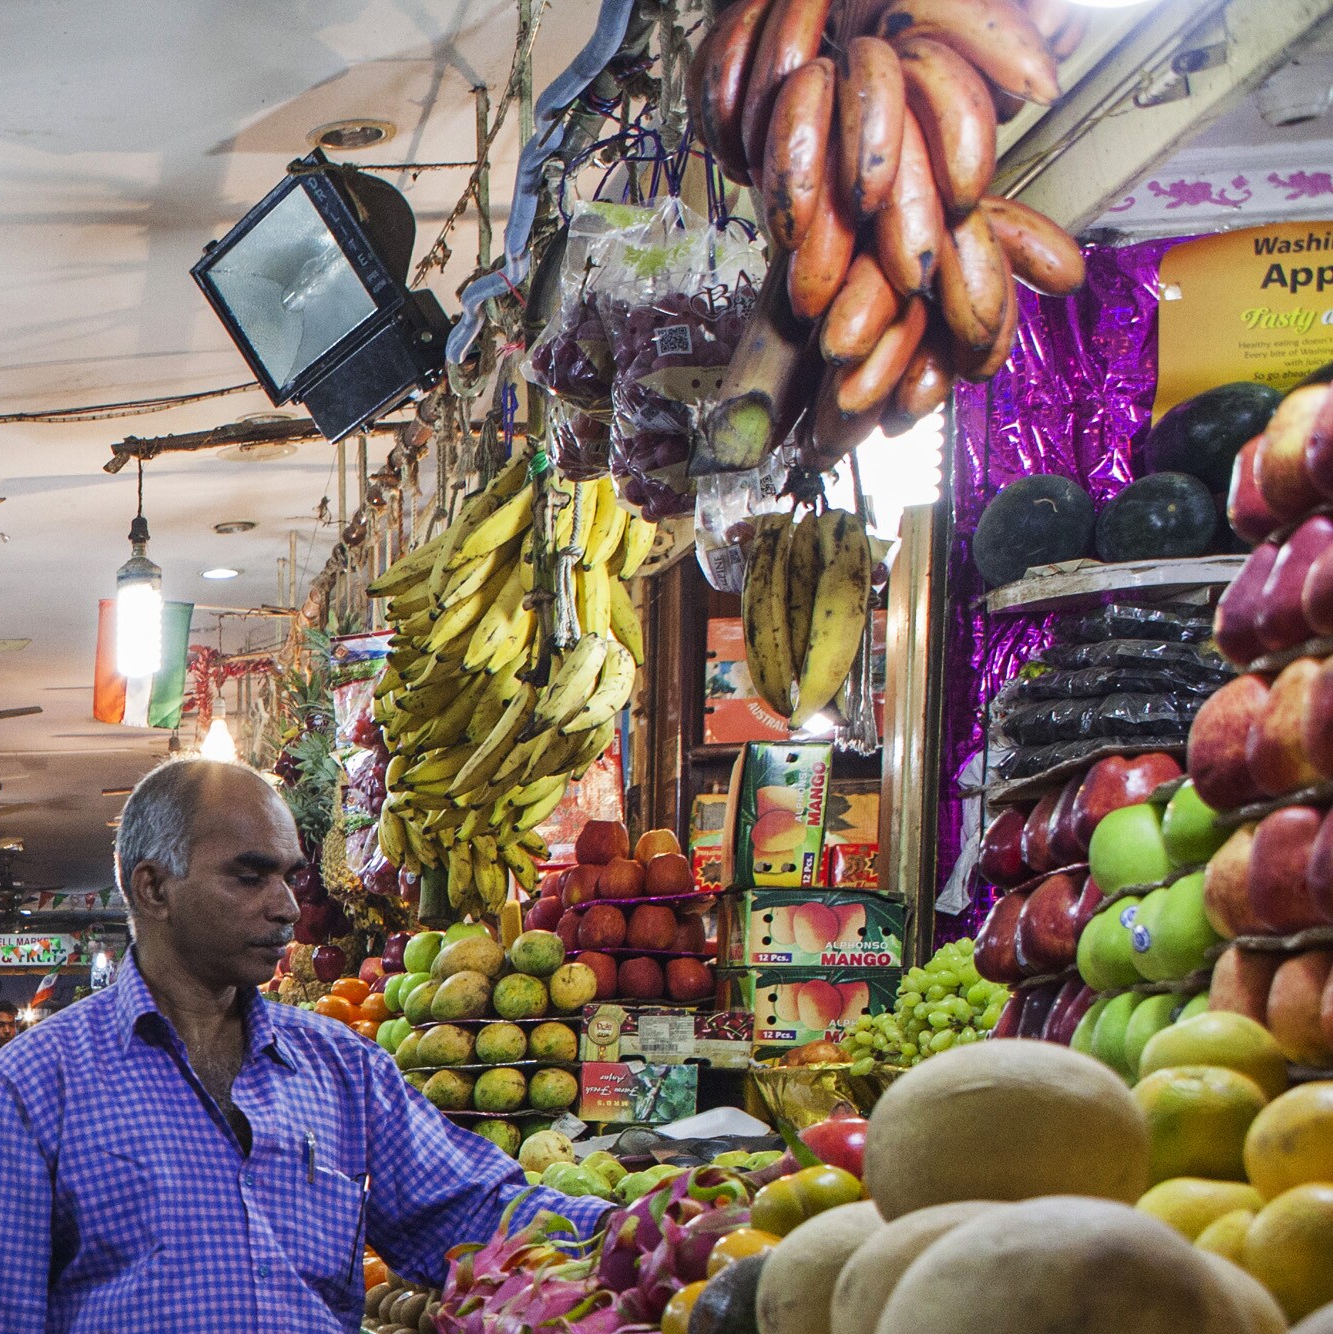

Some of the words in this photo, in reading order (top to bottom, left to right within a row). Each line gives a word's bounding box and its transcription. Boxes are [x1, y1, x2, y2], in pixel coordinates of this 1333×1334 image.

[1260, 263, 1333, 294] App
[1240, 306, 1318, 335] Tasty
[747, 702, 788, 732] AUSTRAL
[807, 761, 826, 827] MANGO
[803, 855, 813, 873] Pcs.
[802, 873, 811, 884] 12
[825, 941, 889, 950] ALPHONSO
[758, 954, 769, 962] 12
[771, 953, 789, 962] Pcs.
[821, 952, 892, 967] MANGO
[762, 1031, 774, 1039] 12
[775, 1031, 794, 1039] Pcs.
